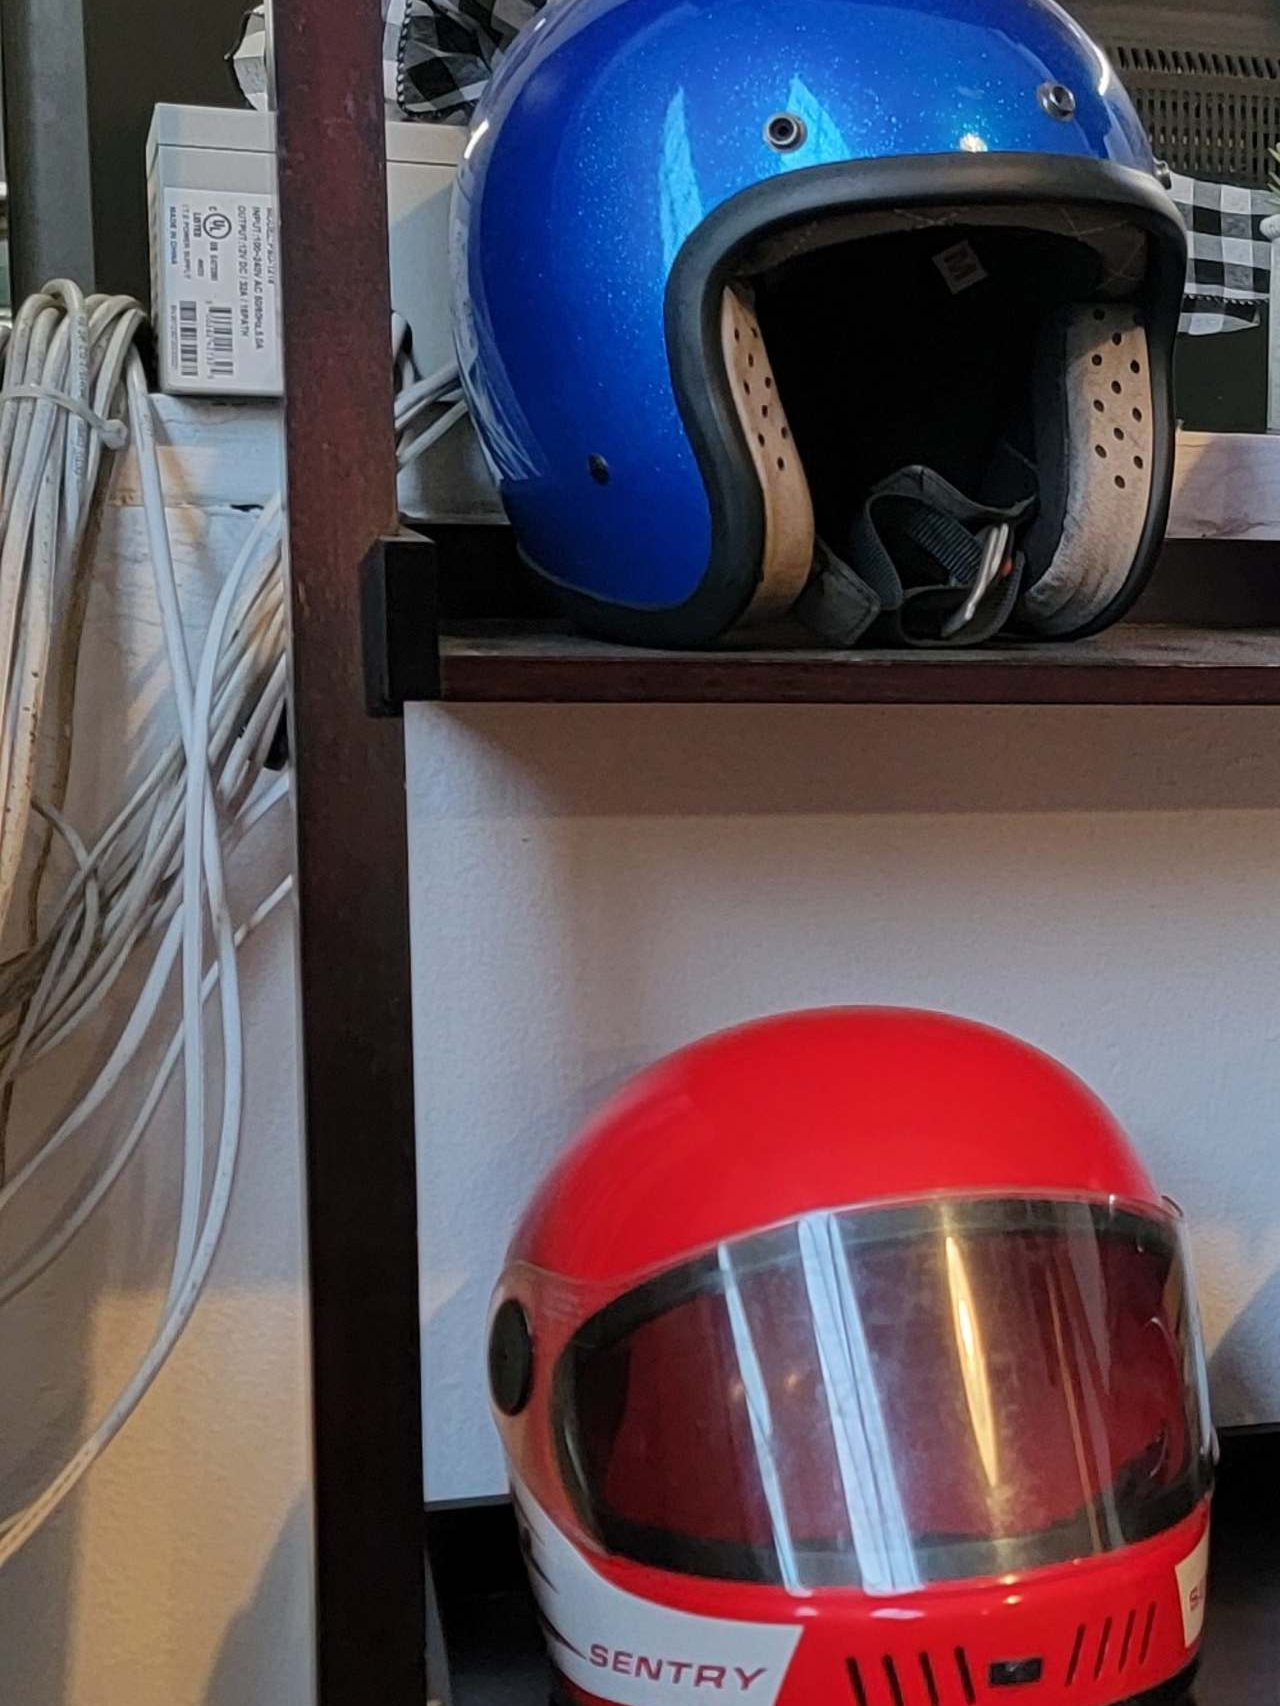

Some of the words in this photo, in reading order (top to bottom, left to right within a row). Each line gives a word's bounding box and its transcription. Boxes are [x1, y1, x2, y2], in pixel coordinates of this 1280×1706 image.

[170, 206, 178, 229] MADE
[171, 241, 179, 265] CHINA
[588, 1643, 768, 1691] SENTRY
